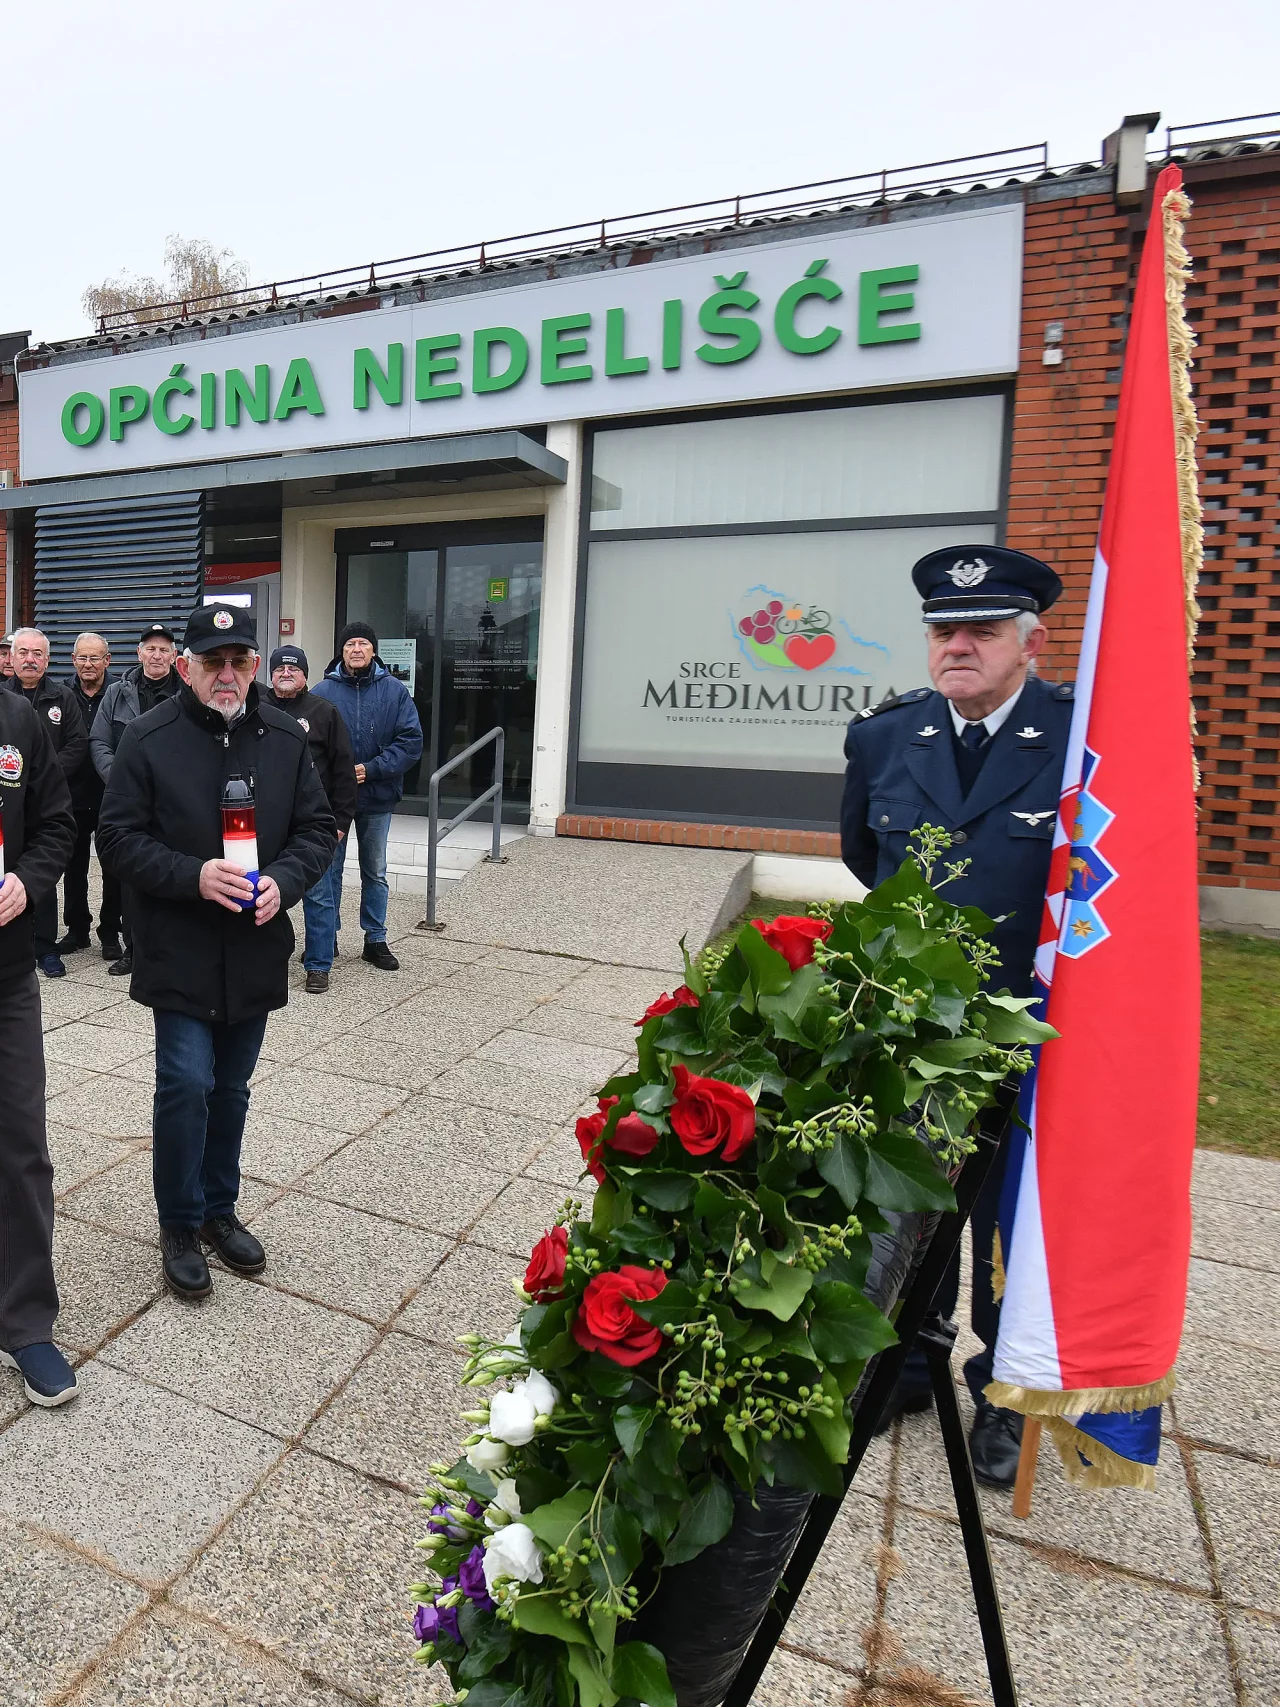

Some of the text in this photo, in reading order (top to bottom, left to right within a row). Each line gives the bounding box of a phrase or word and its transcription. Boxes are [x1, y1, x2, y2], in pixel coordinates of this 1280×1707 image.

[61, 258, 920, 446] OPĆINA NEDELIŠĆE
[679, 661, 741, 679] SRCE
[665, 715, 848, 727] TURISTIČKA ZAJEDNICA PODRUČJA
